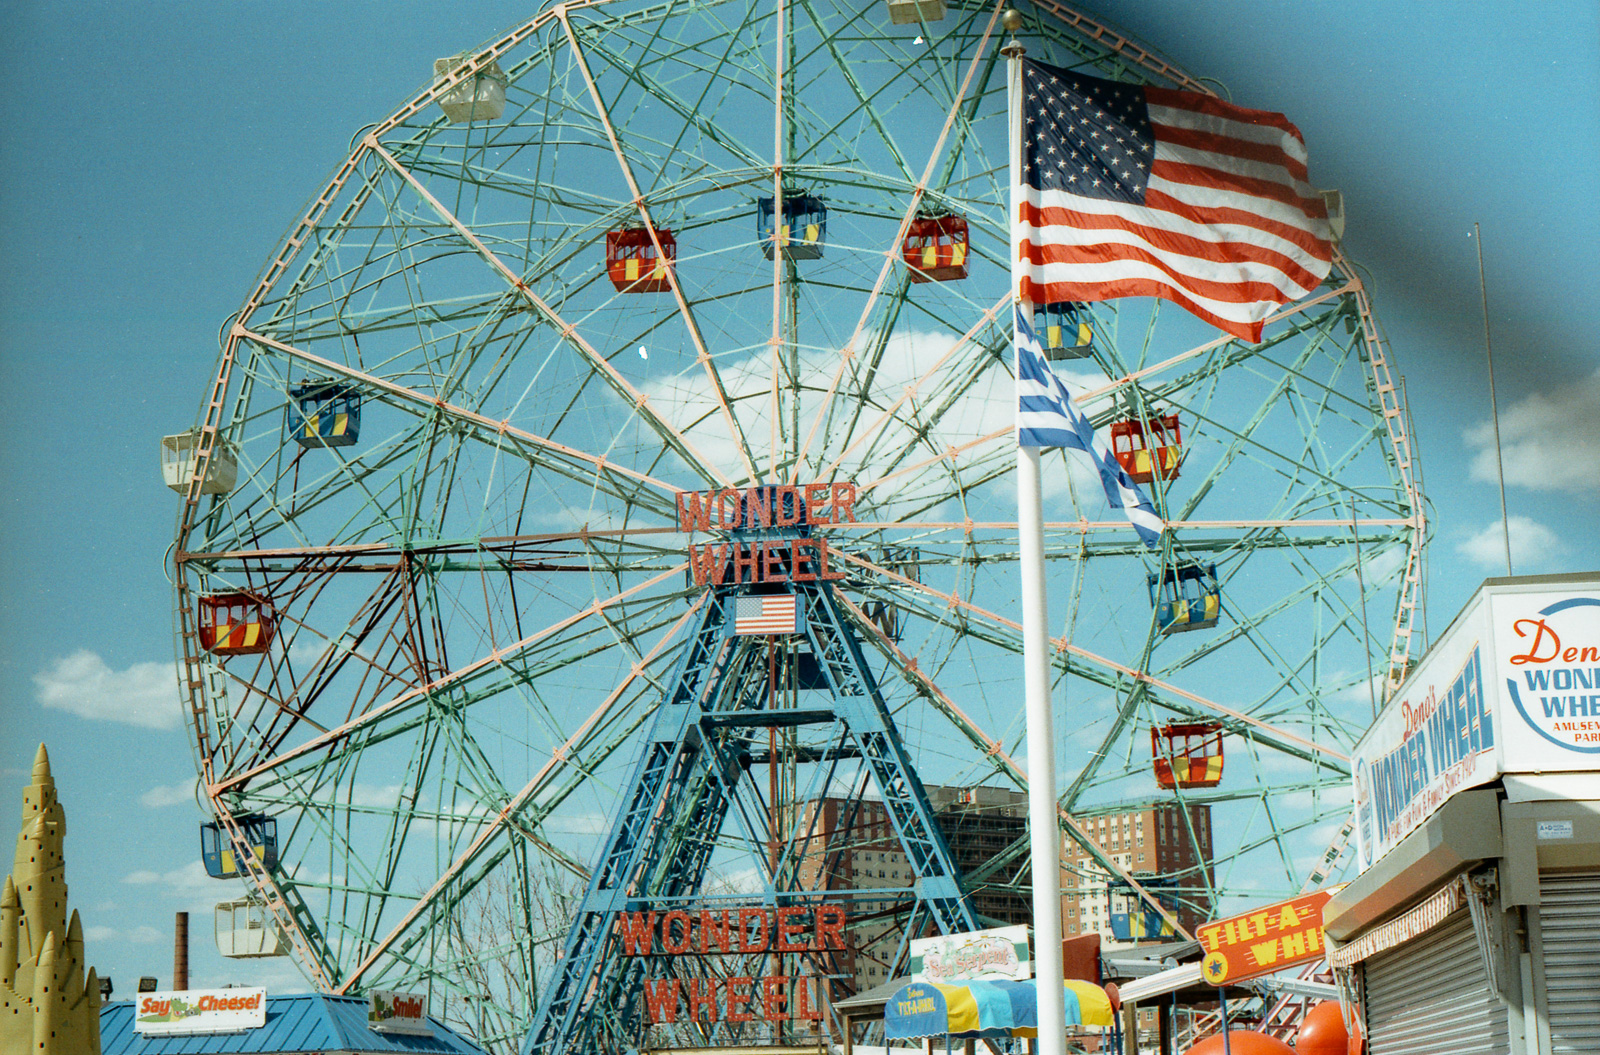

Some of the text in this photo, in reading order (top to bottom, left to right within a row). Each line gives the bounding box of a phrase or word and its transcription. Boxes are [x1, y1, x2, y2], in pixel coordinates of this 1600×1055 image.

[676, 482, 856, 533] WONDER
[688, 537, 846, 586] WHEEL
[1402, 684, 1435, 742] Deno's
[1574, 732, 1600, 742] PAR
[1371, 641, 1494, 845] WONDER WHEEL
[620, 906, 847, 956] WONDER
[1250, 925, 1326, 967] WHI
[929, 947, 1009, 978] Sea Serpent
[140, 993, 262, 1017] Say Cheese!
[392, 996, 424, 1019] Smile!
[644, 975, 824, 1024] WHEEL
